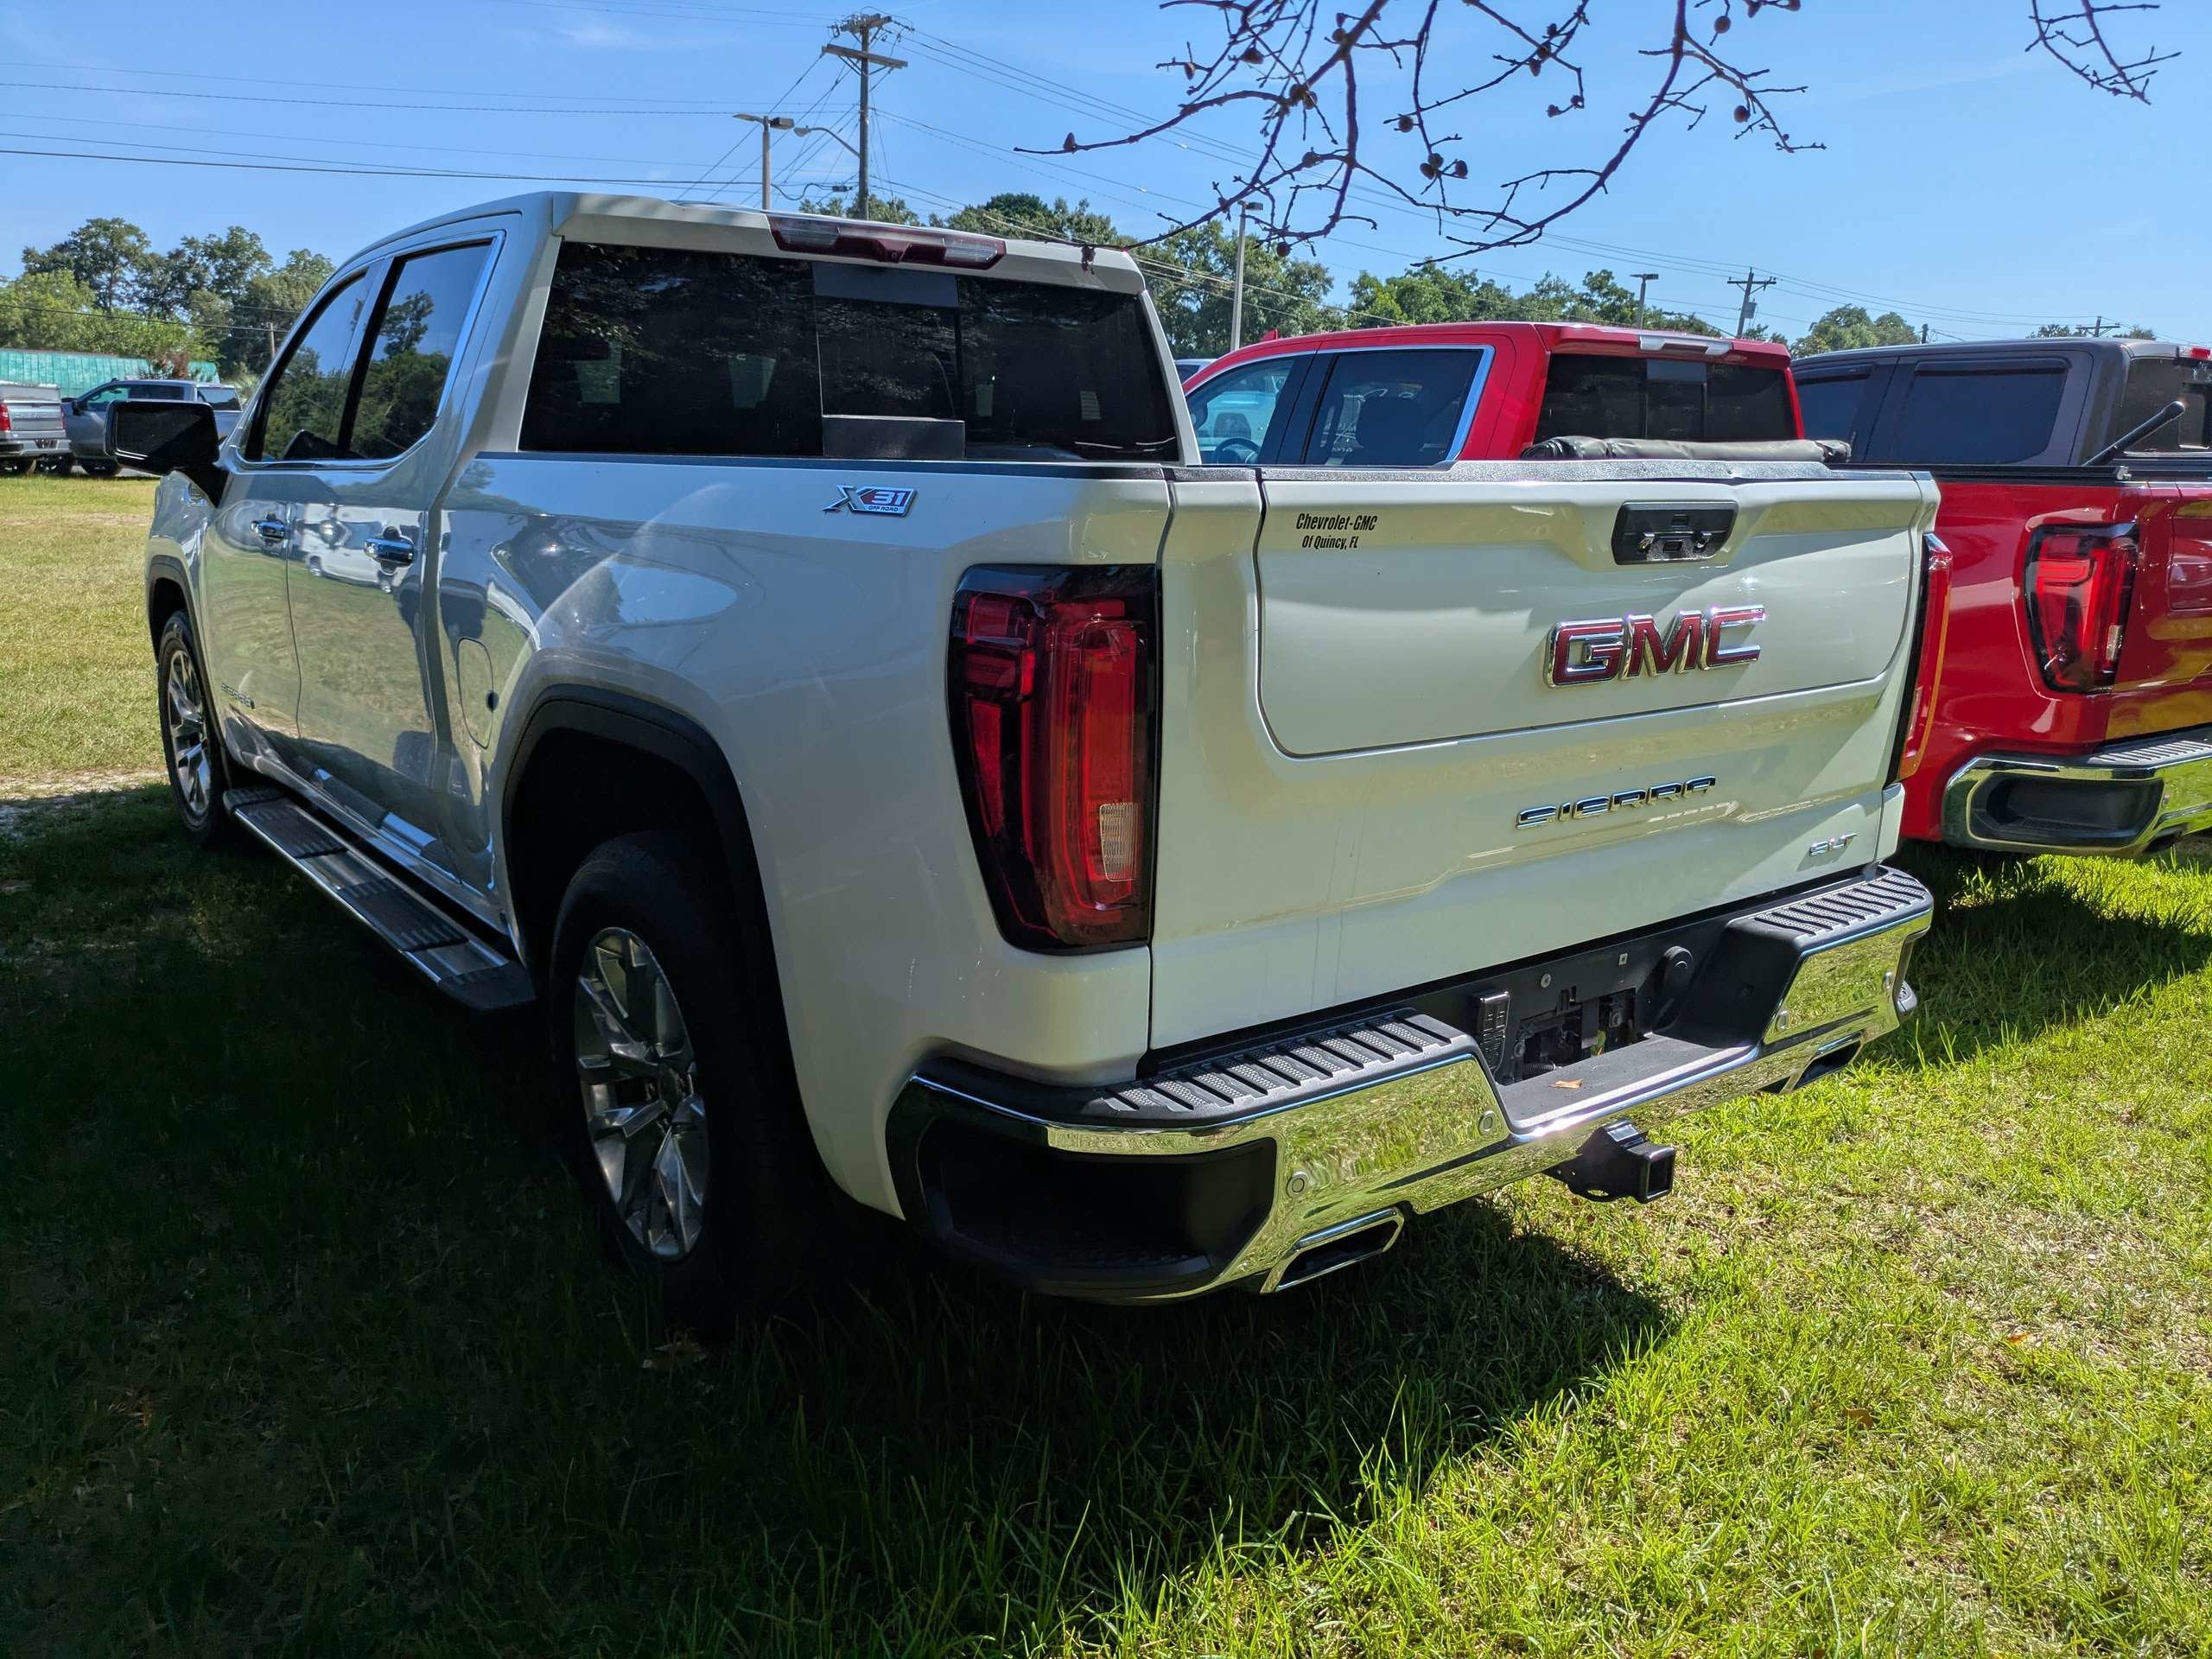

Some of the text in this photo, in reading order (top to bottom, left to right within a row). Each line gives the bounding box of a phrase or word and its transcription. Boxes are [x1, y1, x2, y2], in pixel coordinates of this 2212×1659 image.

[823, 484, 907, 513] X31
[1296, 513, 1377, 531] Chevrolet-GMC
[1301, 535, 1359, 550] Of Quincy, FL
[1544, 605, 1765, 687] GMC
[1516, 775, 1716, 830] SIERRA
[1809, 833, 1858, 856] SLT
